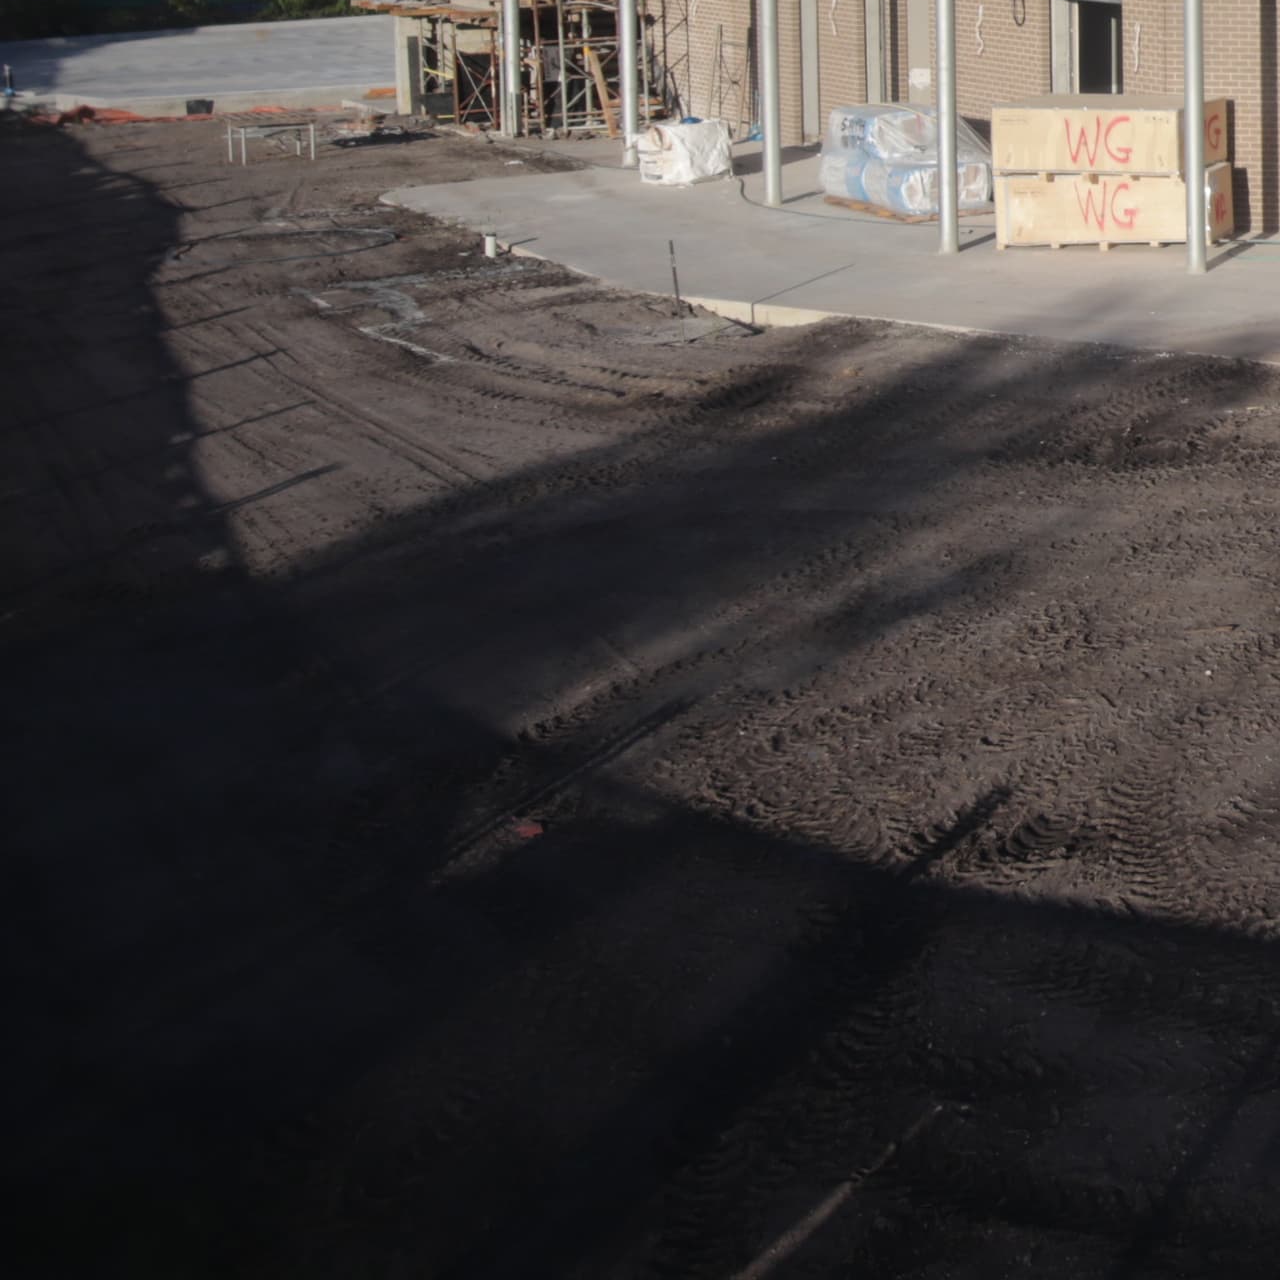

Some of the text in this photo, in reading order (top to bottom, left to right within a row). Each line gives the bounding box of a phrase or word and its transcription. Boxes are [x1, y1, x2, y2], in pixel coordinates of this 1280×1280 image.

[1064, 115, 1133, 167] WG
[1203, 113, 1222, 150] G
[1073, 179, 1139, 232] WG
